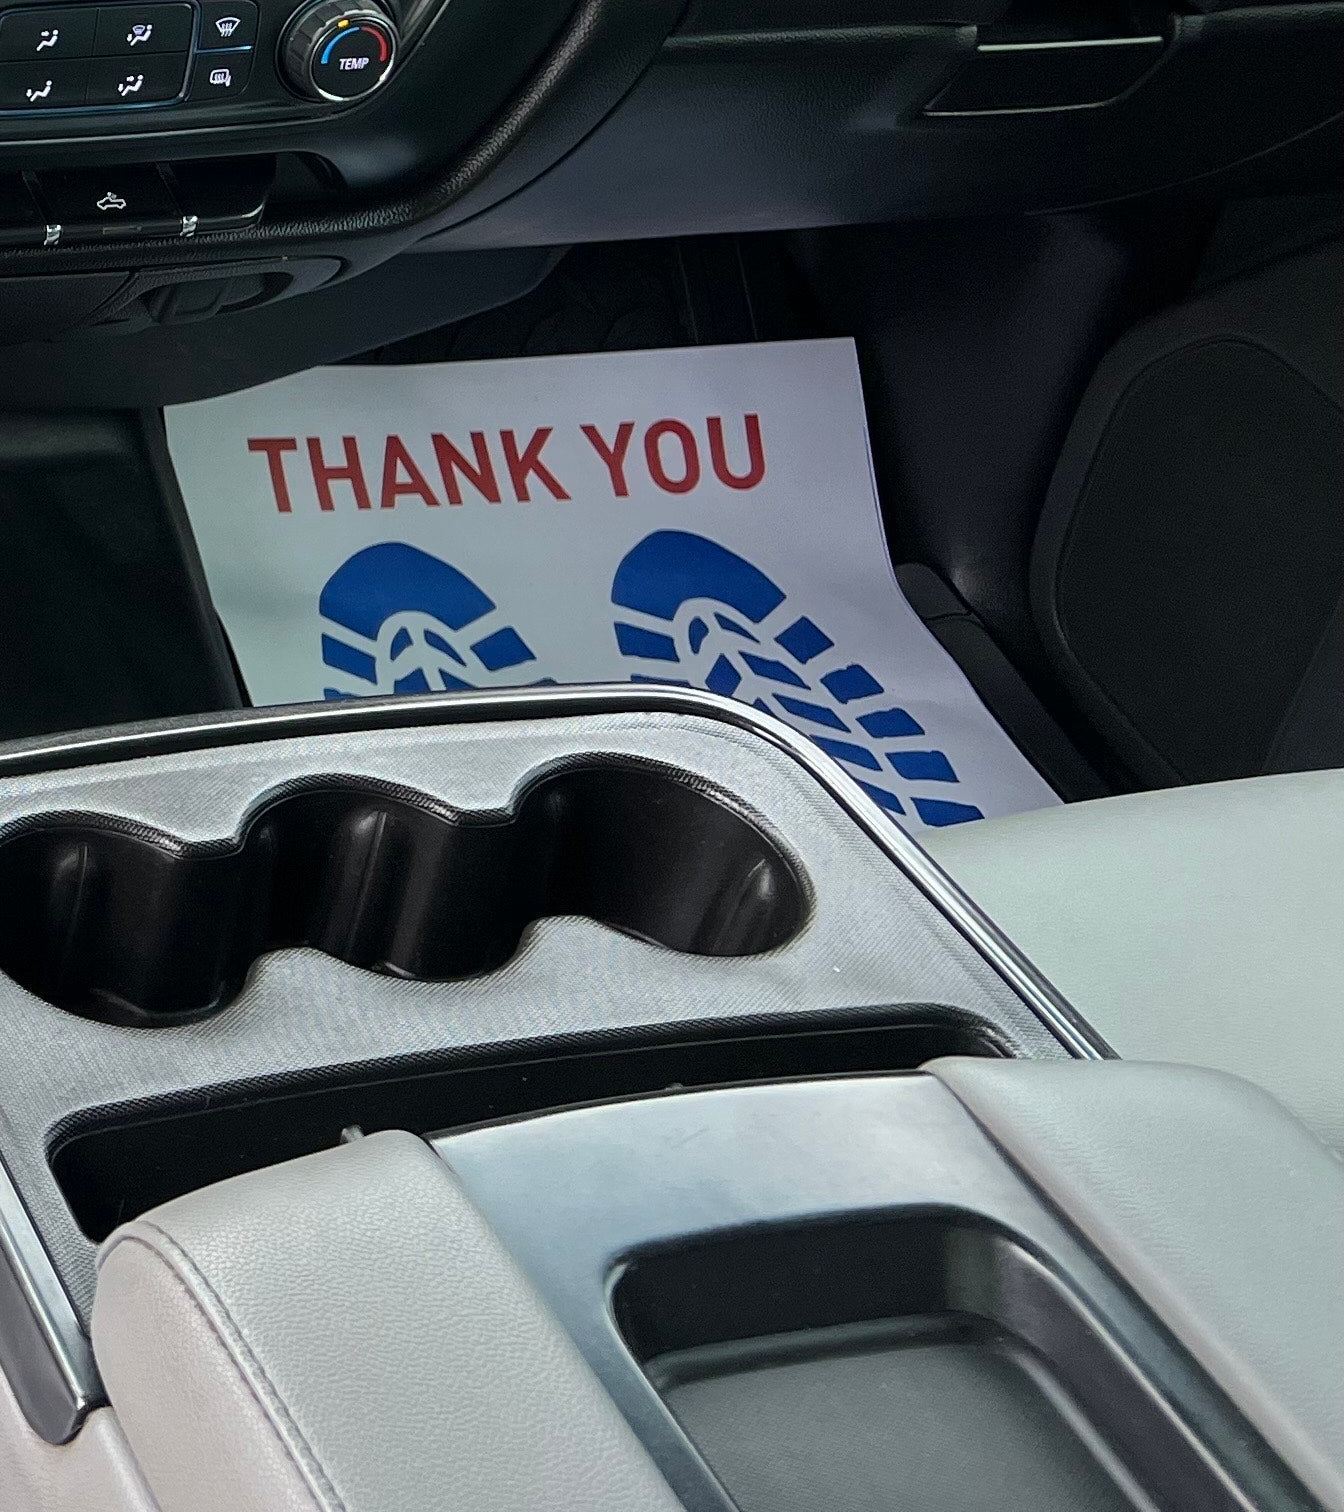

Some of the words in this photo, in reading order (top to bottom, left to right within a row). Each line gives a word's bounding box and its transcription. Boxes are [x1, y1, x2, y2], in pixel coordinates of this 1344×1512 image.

[338, 57, 370, 71] TEMP
[246, 425, 572, 515] THANK
[578, 412, 767, 500] YOU
